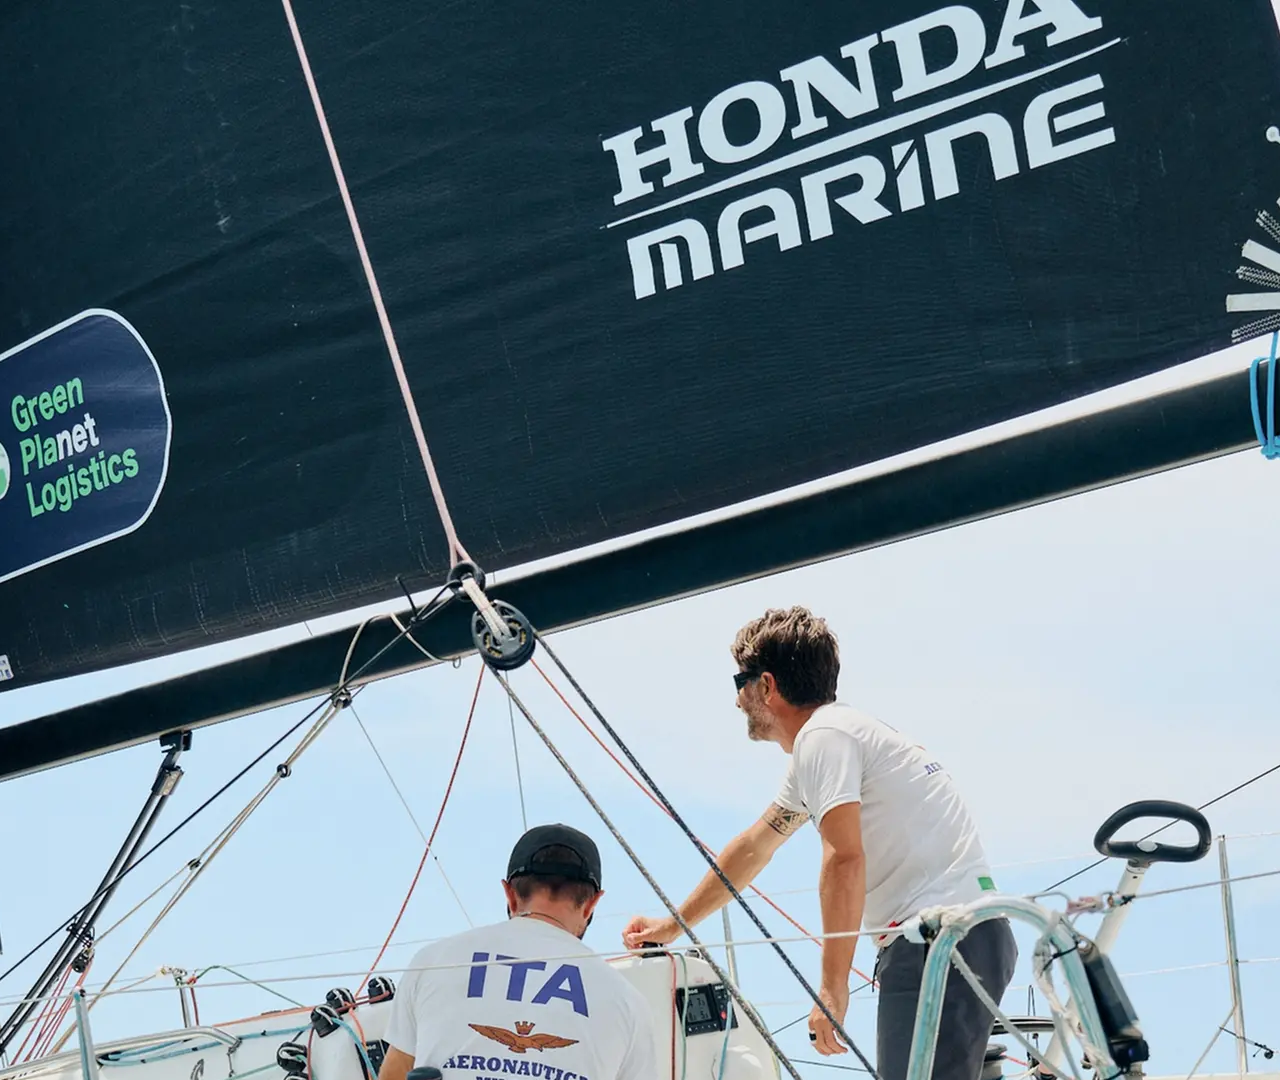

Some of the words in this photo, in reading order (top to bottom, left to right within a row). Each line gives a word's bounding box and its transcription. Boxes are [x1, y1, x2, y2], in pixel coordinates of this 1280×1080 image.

[602, 0, 1104, 206] HONDA
[626, 74, 1116, 300] MARINE
[11, 377, 84, 432] Green
[19, 412, 100, 476] Planet
[25, 448, 139, 517] Logistics
[466, 952, 590, 1018] ITA
